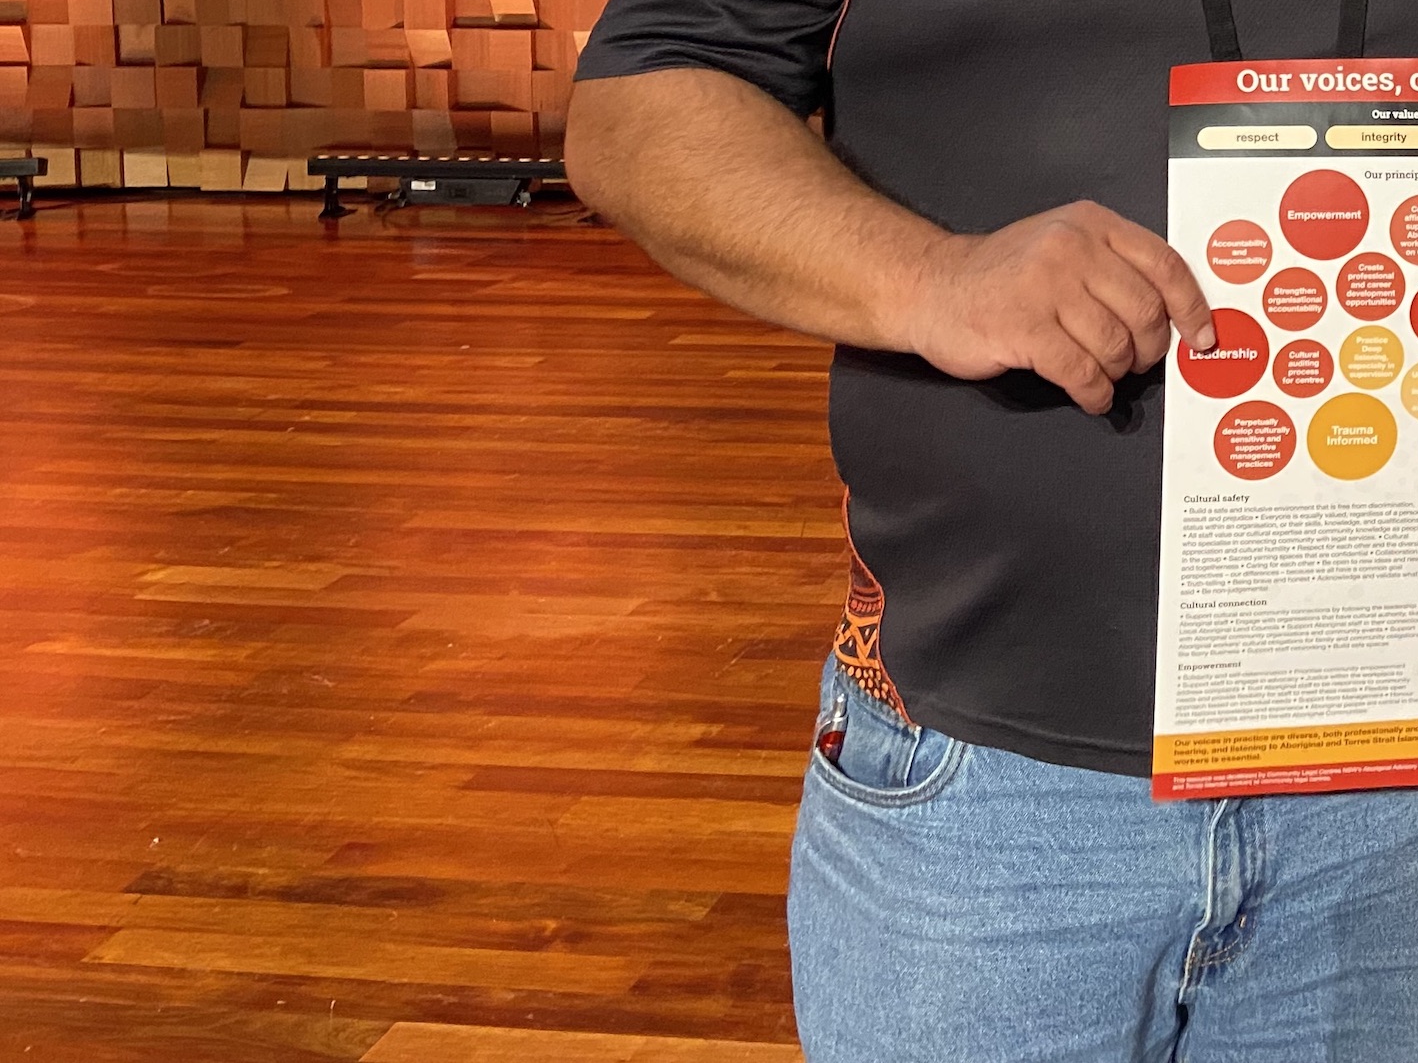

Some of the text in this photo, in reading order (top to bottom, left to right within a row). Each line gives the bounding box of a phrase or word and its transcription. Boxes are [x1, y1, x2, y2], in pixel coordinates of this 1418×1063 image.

[1236, 69, 1292, 93] Our
[1300, 67, 1402, 96] voices,
[1372, 110, 1391, 119] Our
[1236, 133, 1279, 143] respect
[1361, 132, 1407, 144] integrity
[1365, 171, 1382, 179] Our
[1288, 210, 1361, 221] Empowerment
[1212, 240, 1267, 248] Accountability
[1213, 257, 1267, 266] Responsibility
[1348, 273, 1394, 281] professional
[1274, 288, 1316, 296] Strengthen
[1346, 290, 1395, 298] development
[1268, 296, 1322, 305] organisational
[1346, 298, 1396, 307] opportunities
[1268, 305, 1322, 313] accountability
[1289, 351, 1319, 359] Cultural
[1288, 359, 1319, 368] auditing
[1235, 419, 1279, 427] Perpetually
[1222, 426, 1290, 435] develop culturally
[1332, 425, 1373, 436] Trauma
[1266, 435, 1281, 443] and
[1327, 436, 1378, 446] Informed
[1235, 444, 1276, 453] supportive
[1230, 452, 1280, 460] management
[1184, 494, 1250, 503] Cultural safety
[1218, 599, 1267, 607] connection
[1178, 662, 1241, 671] Empowerment
[1174, 739, 1190, 747] Our
[1193, 738, 1220, 746] voices
[1233, 736, 1268, 745] practice
[1287, 732, 1320, 740] diverse,
[1344, 727, 1403, 738] professionally
[1174, 748, 1208, 756] hearing,
[1230, 744, 1266, 753] listening
[1280, 741, 1324, 749] Aboriginal
[1174, 757, 1209, 765] workers
[1221, 754, 1262, 763] essential.
